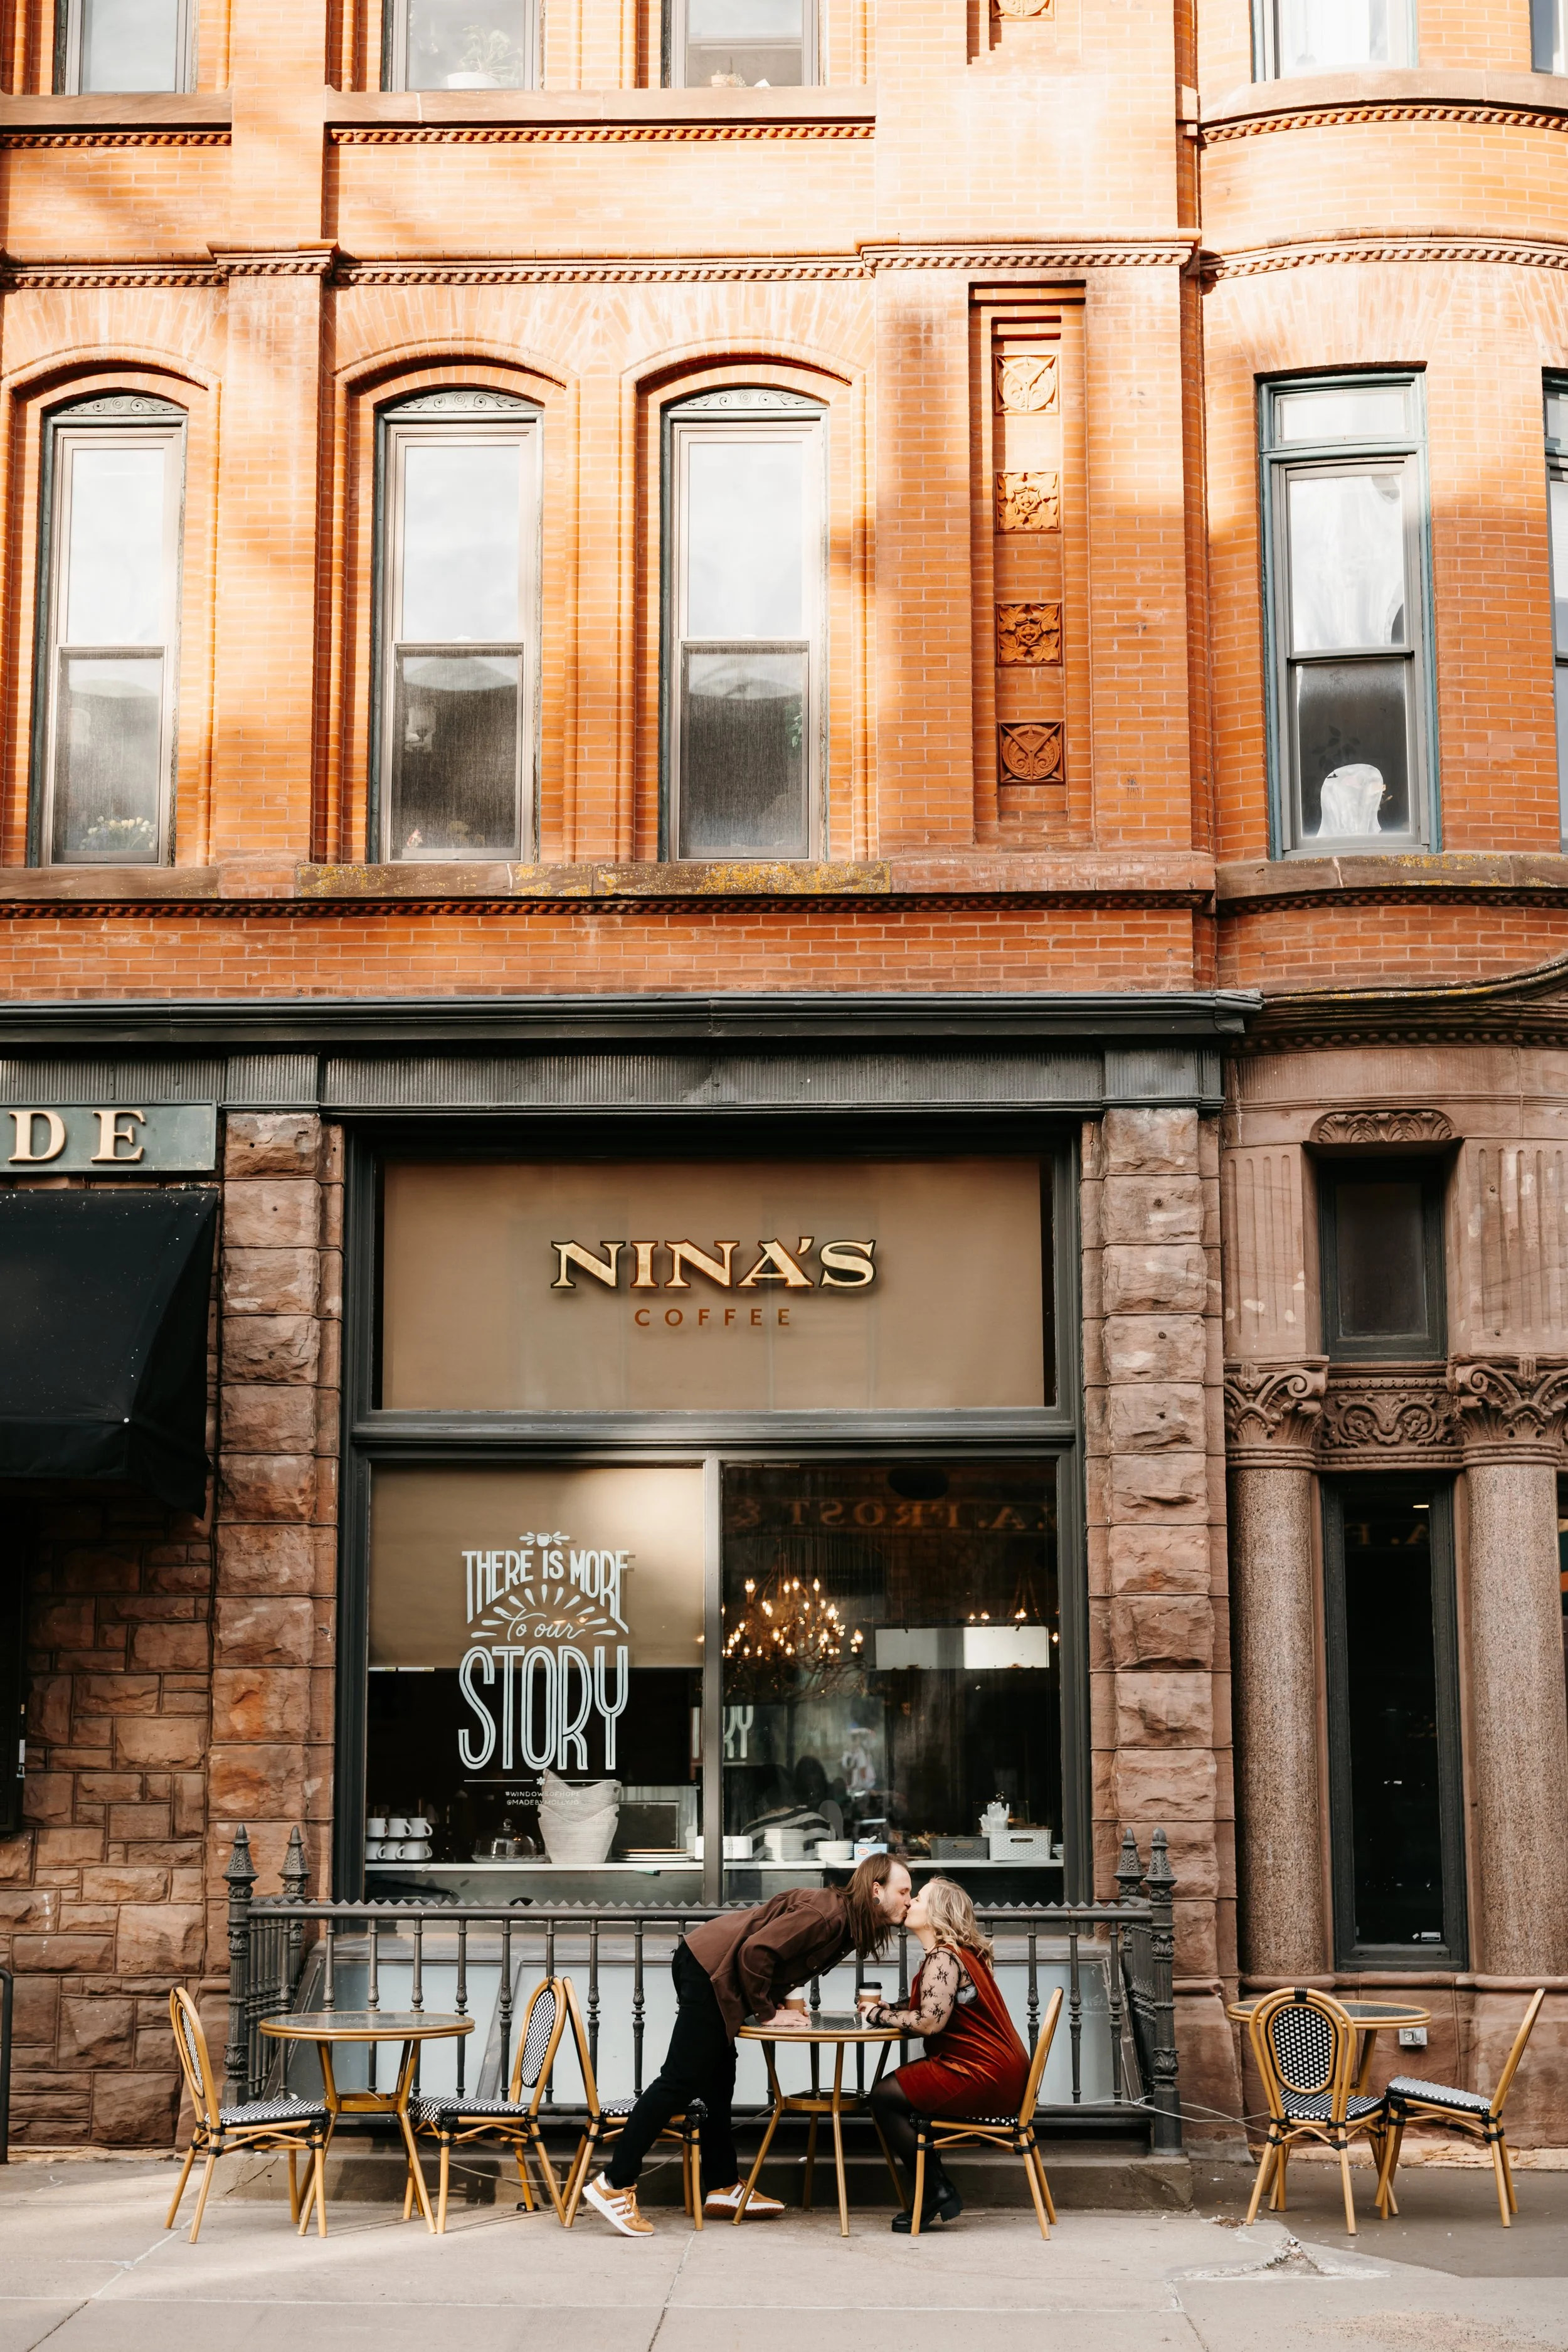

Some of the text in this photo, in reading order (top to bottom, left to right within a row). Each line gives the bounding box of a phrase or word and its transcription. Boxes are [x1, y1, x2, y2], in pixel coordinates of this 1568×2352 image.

[8, 1110, 146, 1163] DE
[550, 1236, 877, 1289] NINA'S
[634, 1308, 790, 1327] COFFEE
[462, 1550, 630, 1634] THERE IS MORE
[534, 1623, 586, 1639] our
[458, 1646, 628, 1771] STORY
